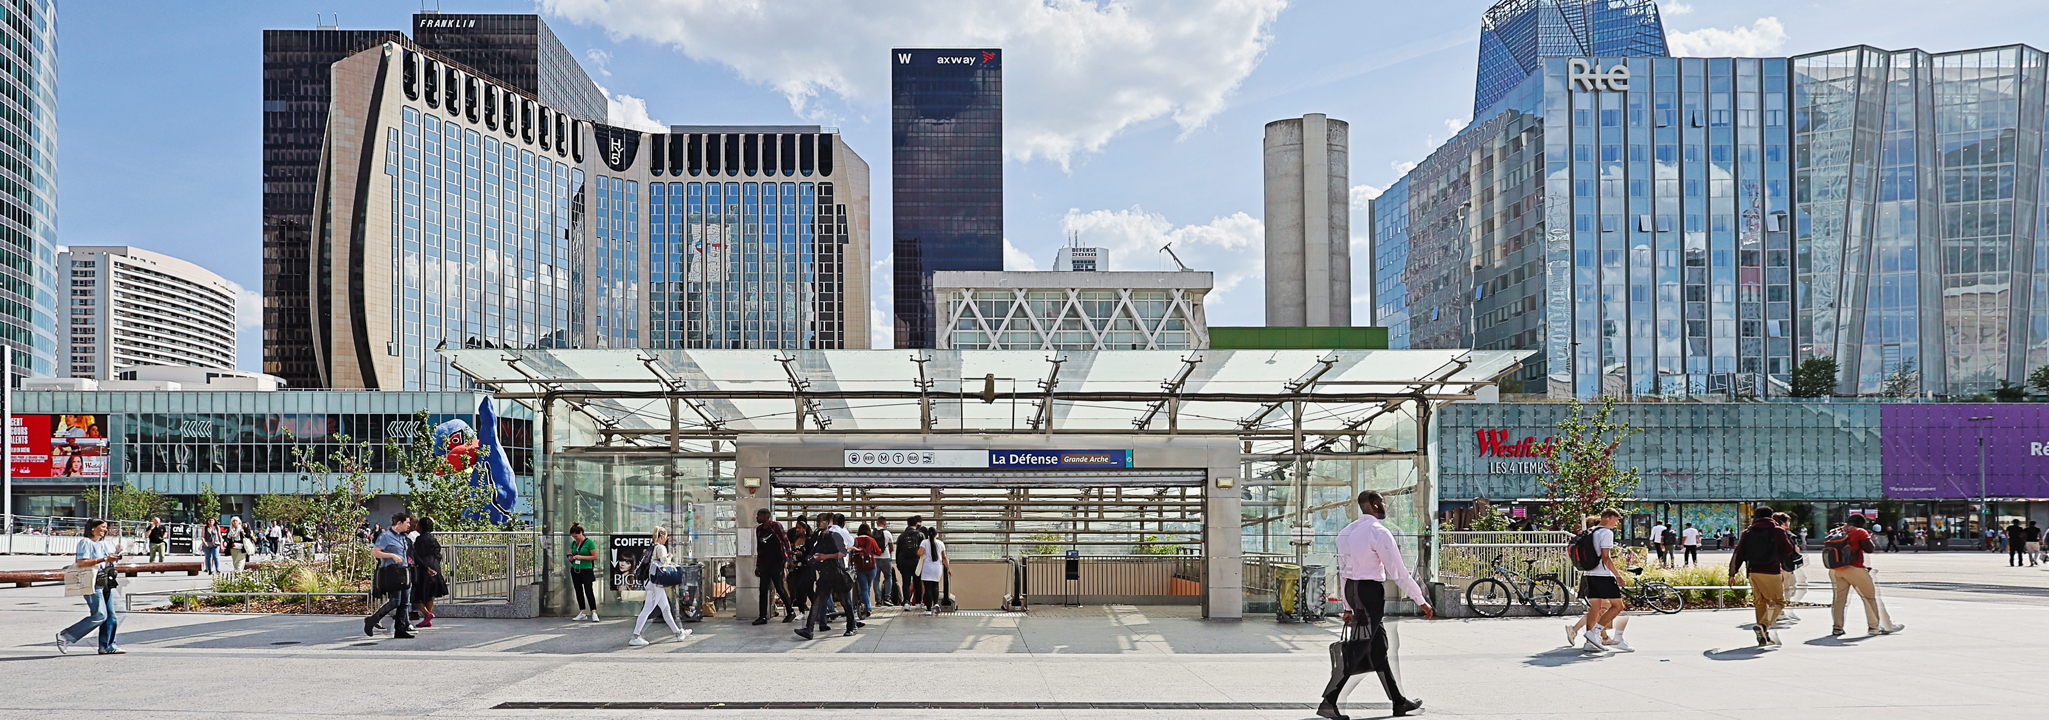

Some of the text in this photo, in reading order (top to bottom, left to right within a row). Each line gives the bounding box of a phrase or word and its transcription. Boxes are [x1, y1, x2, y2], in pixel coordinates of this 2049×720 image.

[420, 19, 476, 28] FRANKLIN
[897, 53, 912, 64] W
[937, 56, 976, 66] axway
[1568, 58, 1631, 90] Rte
[992, 453, 1006, 465] La
[1009, 453, 1058, 465] Défense
[1490, 462, 1551, 473] LES 4 TEMPS
